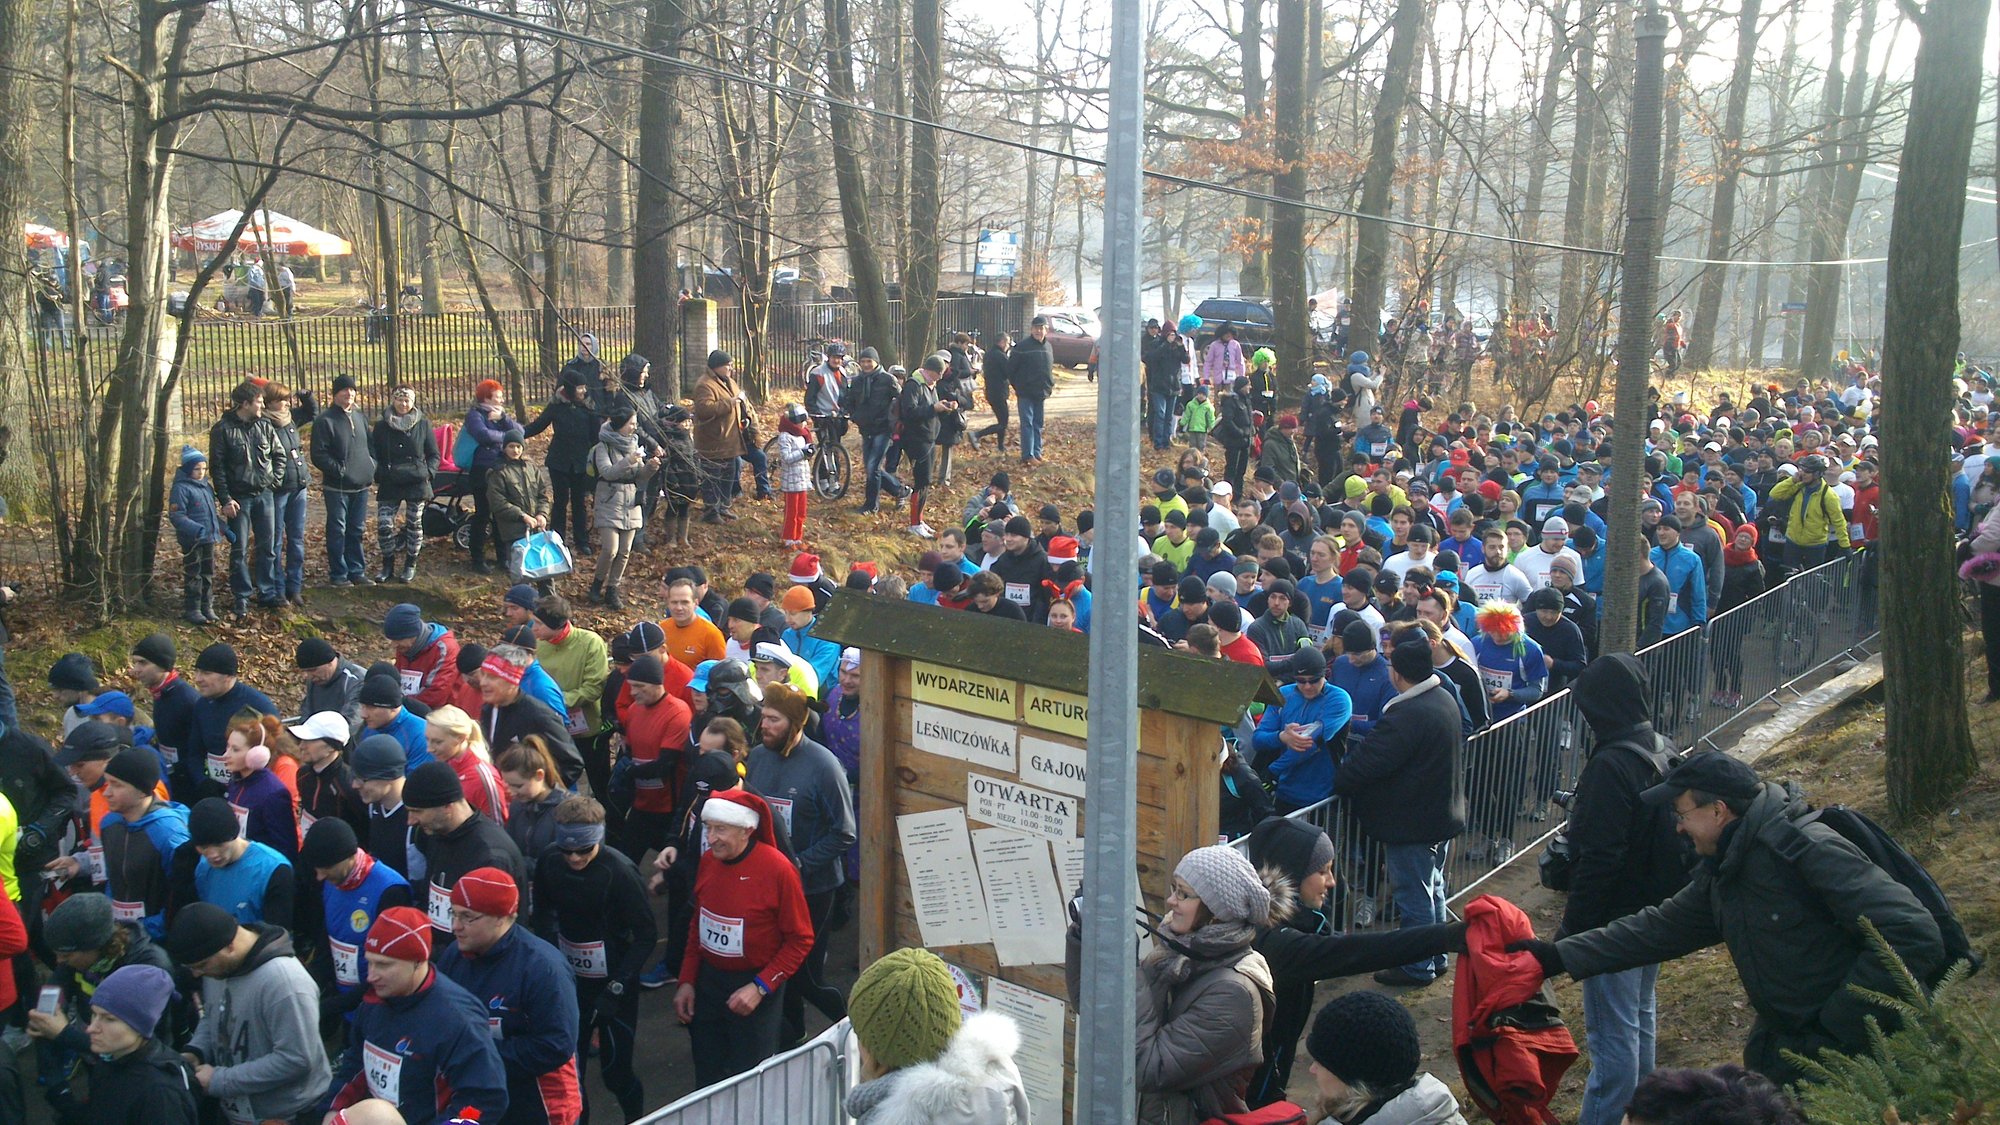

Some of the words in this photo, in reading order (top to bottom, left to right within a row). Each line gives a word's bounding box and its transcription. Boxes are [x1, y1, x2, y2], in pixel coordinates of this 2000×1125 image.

[916, 671, 1010, 704] WYDARZENIA
[916, 721, 1011, 757] LEŚNICZÓWKA
[974, 779, 1070, 818] OTWARTA
[979, 808, 992, 817] SOB
[1020, 818, 1039, 830] 10.00
[1044, 825, 1063, 837] 20.00
[1020, 808, 1039, 819] 11.00
[1044, 814, 1063, 826] 20.00
[706, 928, 729, 946] 770
